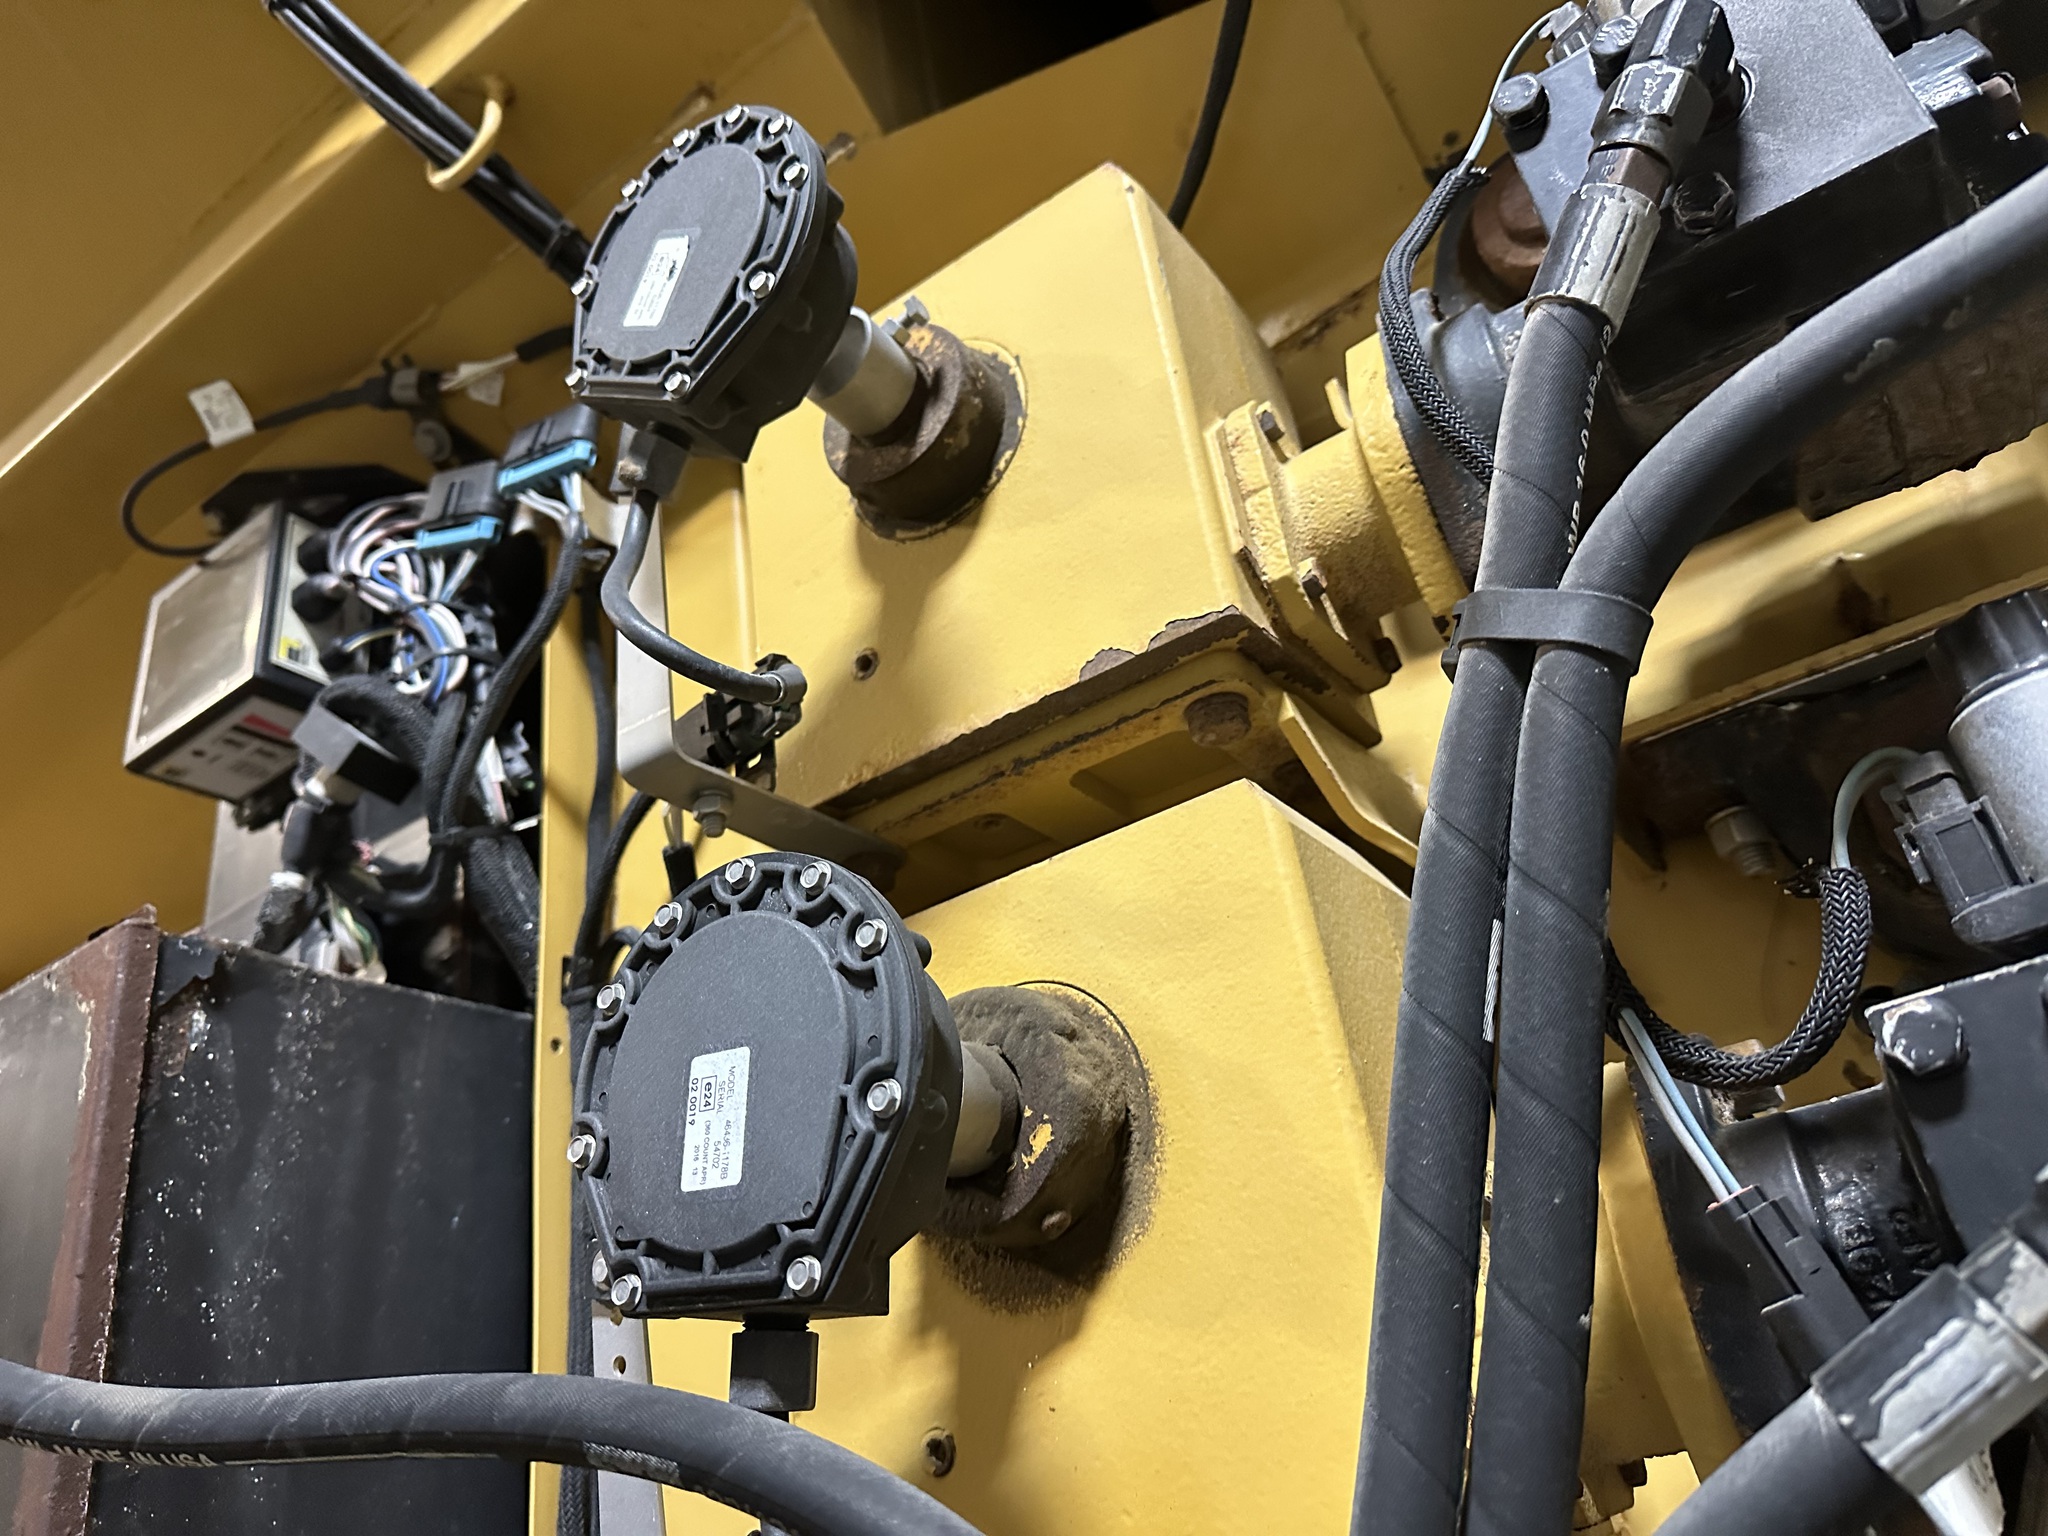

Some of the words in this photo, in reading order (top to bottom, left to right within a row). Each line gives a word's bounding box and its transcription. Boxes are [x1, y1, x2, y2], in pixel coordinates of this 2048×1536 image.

[690, 1077, 699, 1093] 02
[703, 1081, 713, 1108] e24
[716, 1080, 726, 1114] SERIAL
[726, 1065, 736, 1101] MODEL
[688, 1096, 698, 1126] 0019
[701, 1137, 711, 1165] COUNT
[711, 1140, 721, 1170] 54702
[699, 1165, 708, 1186] APR)
[129, 1451, 161, 1466] IN
[160, 1452, 219, 1467] USA
